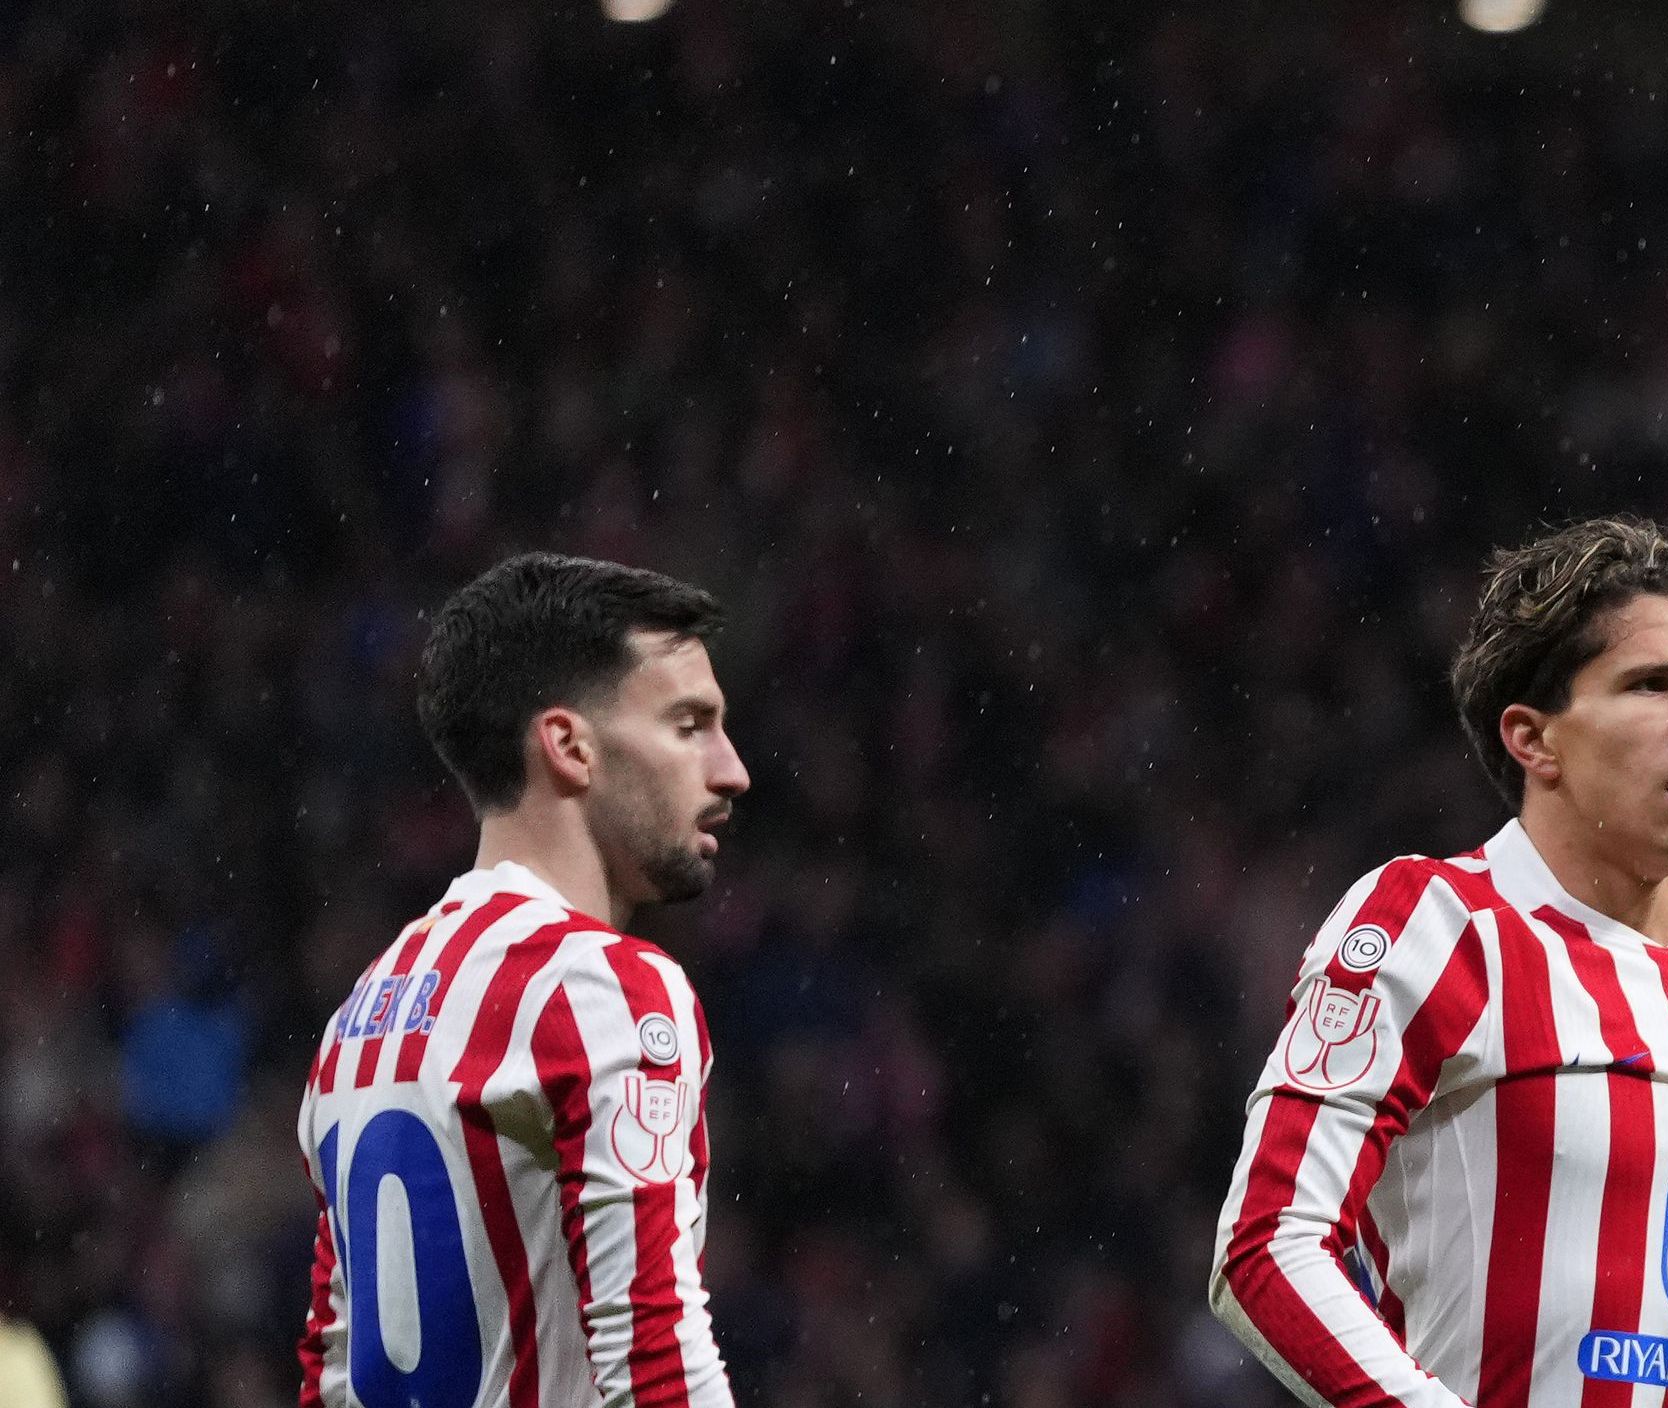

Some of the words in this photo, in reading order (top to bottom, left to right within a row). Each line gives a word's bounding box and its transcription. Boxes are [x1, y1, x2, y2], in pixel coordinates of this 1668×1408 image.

[1351, 939, 1378, 957] 10
[404, 968, 443, 1035] B.
[648, 1031, 671, 1045] 10
